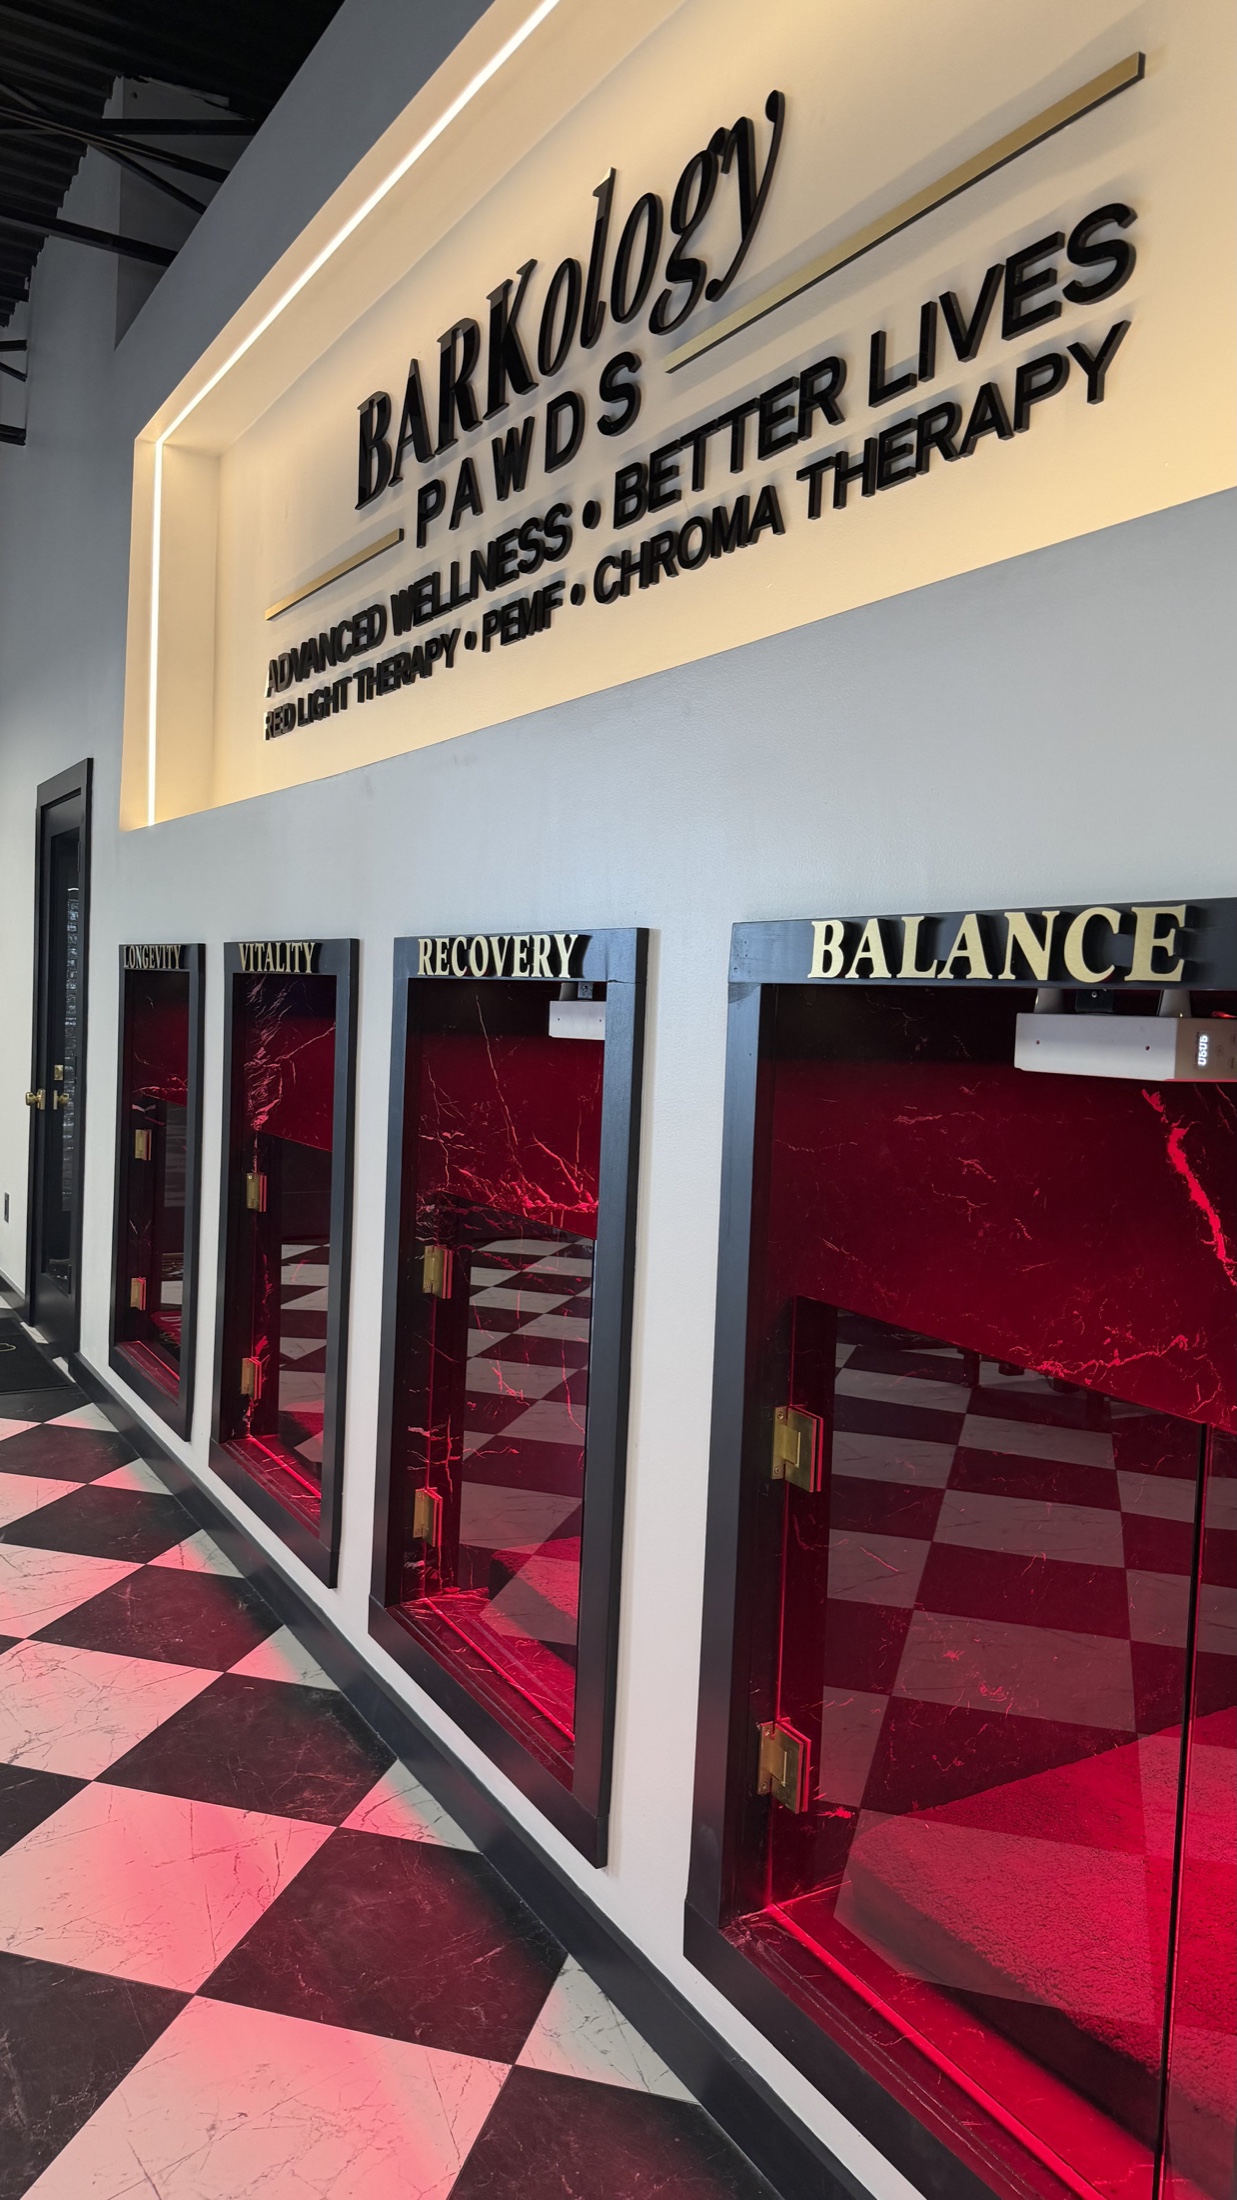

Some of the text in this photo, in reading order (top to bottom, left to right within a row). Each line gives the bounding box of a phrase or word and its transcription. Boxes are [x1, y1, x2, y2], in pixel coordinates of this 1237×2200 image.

[355, 89, 786, 512] BARKology
[264, 202, 1138, 698] ADVANCED WELLNESS BETTER LIVES
[416, 351, 642, 549] PAWDS
[263, 319, 1131, 740] RED LIGHT THERAPY PEMF CHROMA THERAPY
[123, 944, 183, 970] LONGEVITY
[238, 942, 316, 973] VITALITY
[417, 933, 579, 979] RECOVERY
[807, 904, 1187, 984] BALANCE
